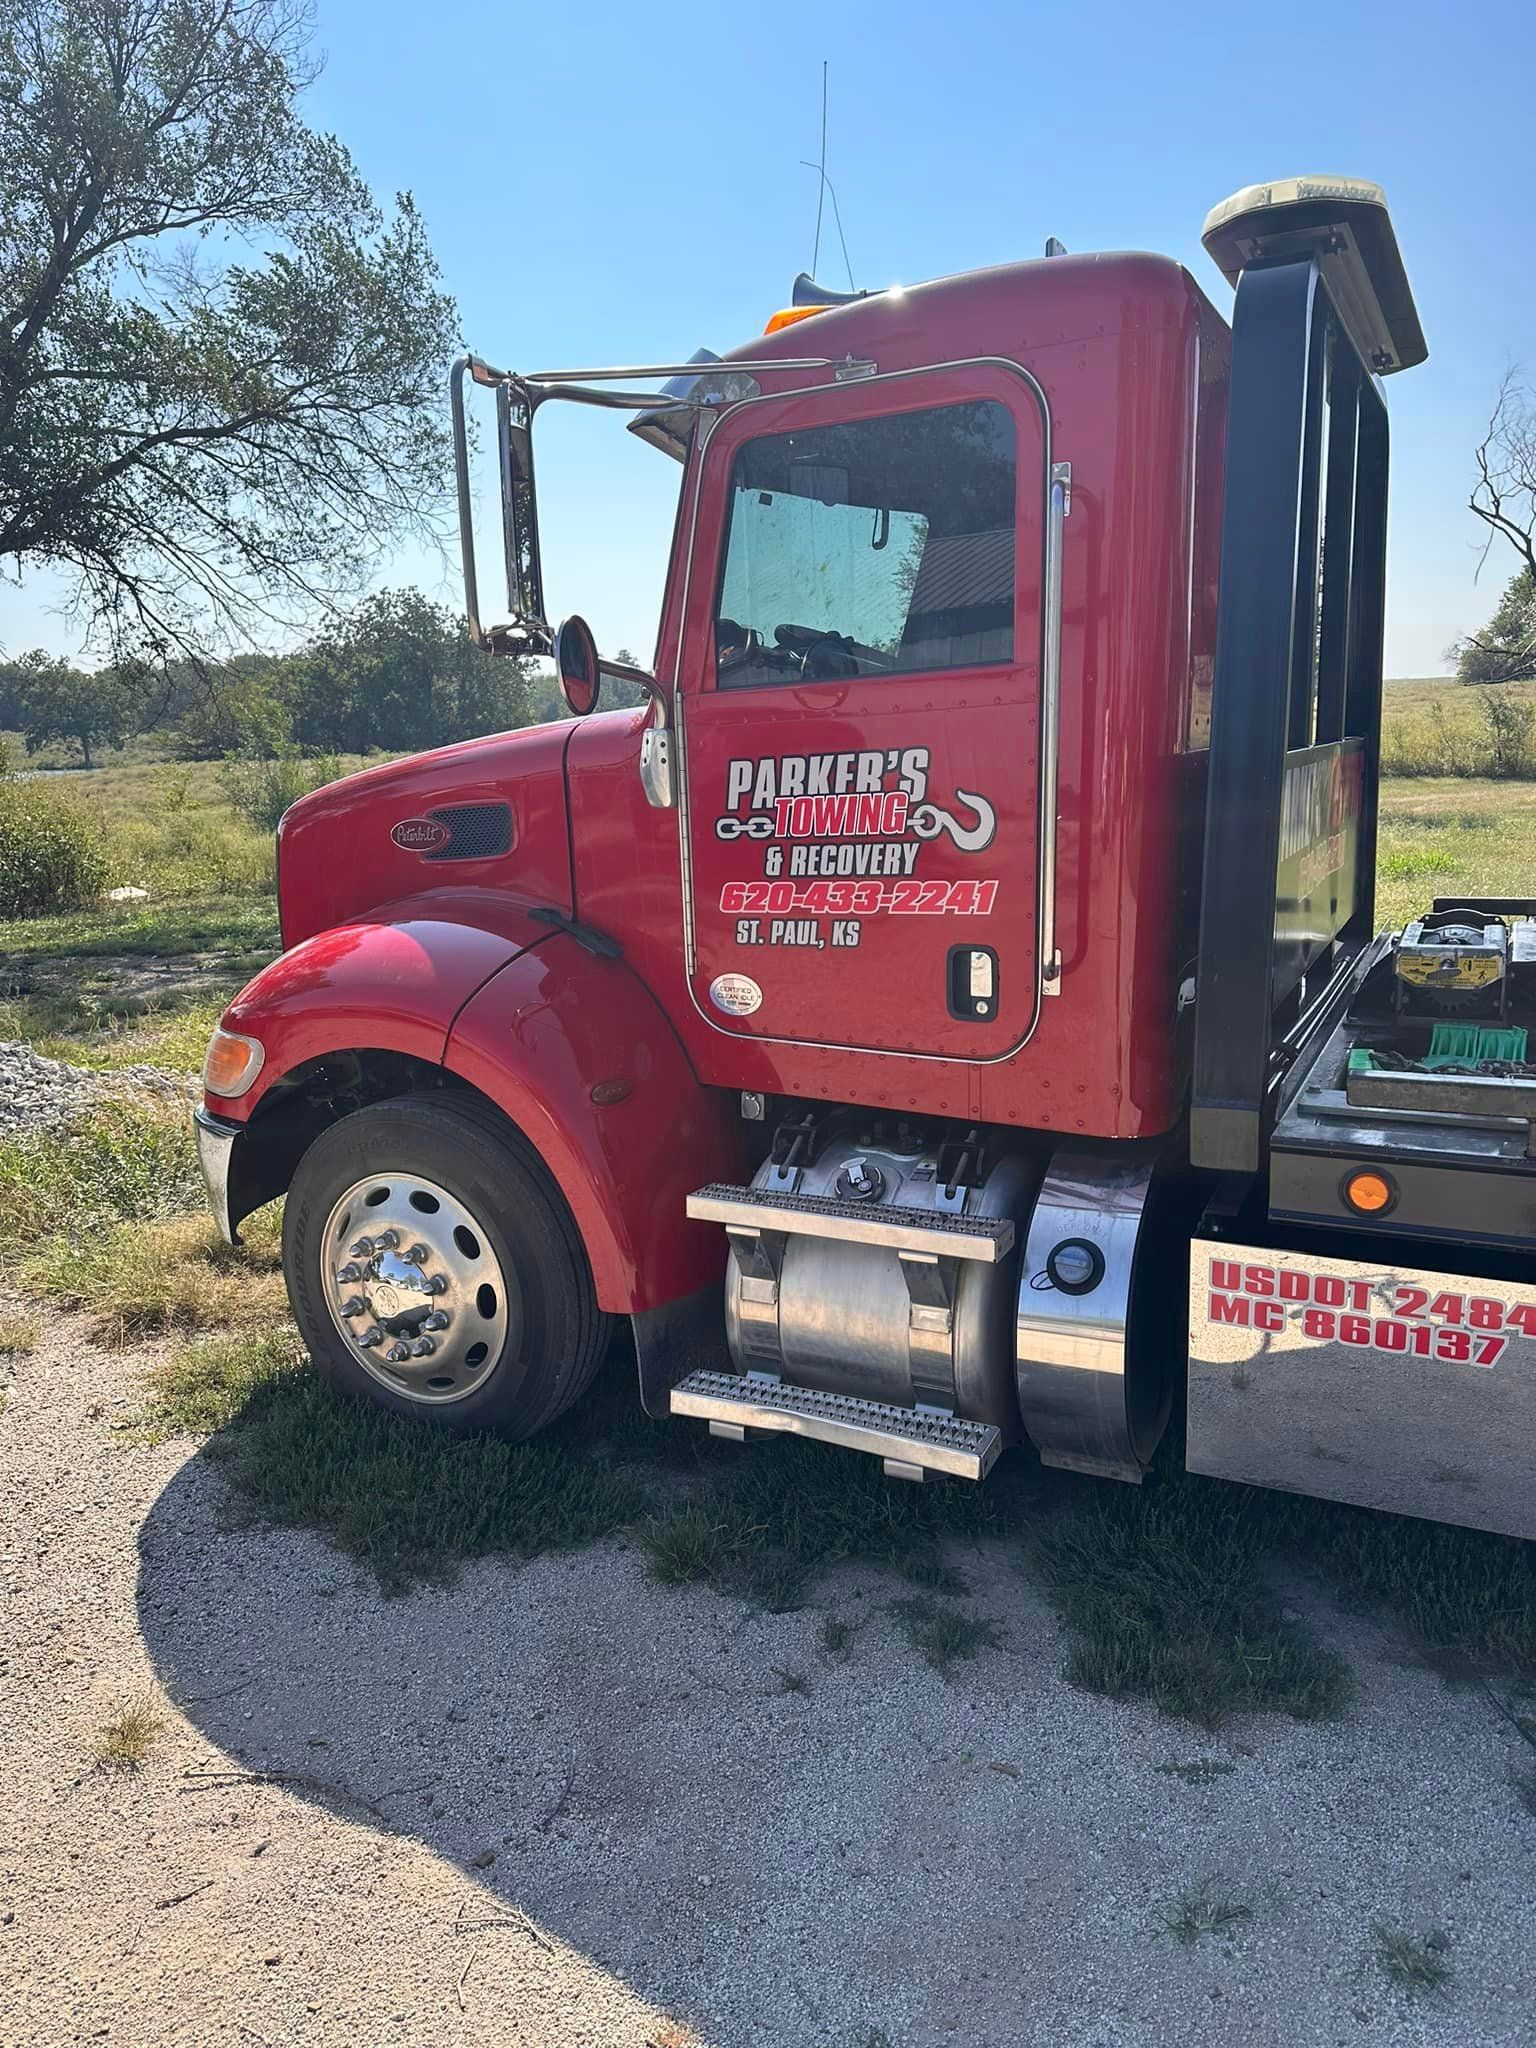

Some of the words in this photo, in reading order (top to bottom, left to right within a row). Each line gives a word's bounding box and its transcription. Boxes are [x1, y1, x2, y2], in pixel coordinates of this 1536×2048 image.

[727, 748, 930, 811] PARKER'S
[774, 792, 909, 838] TOWING
[397, 825, 440, 843] Peterbilt
[764, 845, 784, 877] &
[788, 842, 921, 877] RECOVERY
[719, 880, 999, 915] 620-433-2241
[735, 919, 764, 945] ST.
[769, 919, 826, 950] PAUL,
[830, 919, 862, 947] KS
[719, 986, 752, 994] CERTIFIED
[1209, 1258, 1375, 1312] USDOT
[1393, 1286, 1536, 1338] 2484
[1208, 1291, 1287, 1334] MC
[1302, 1308, 1510, 1368] 860137
